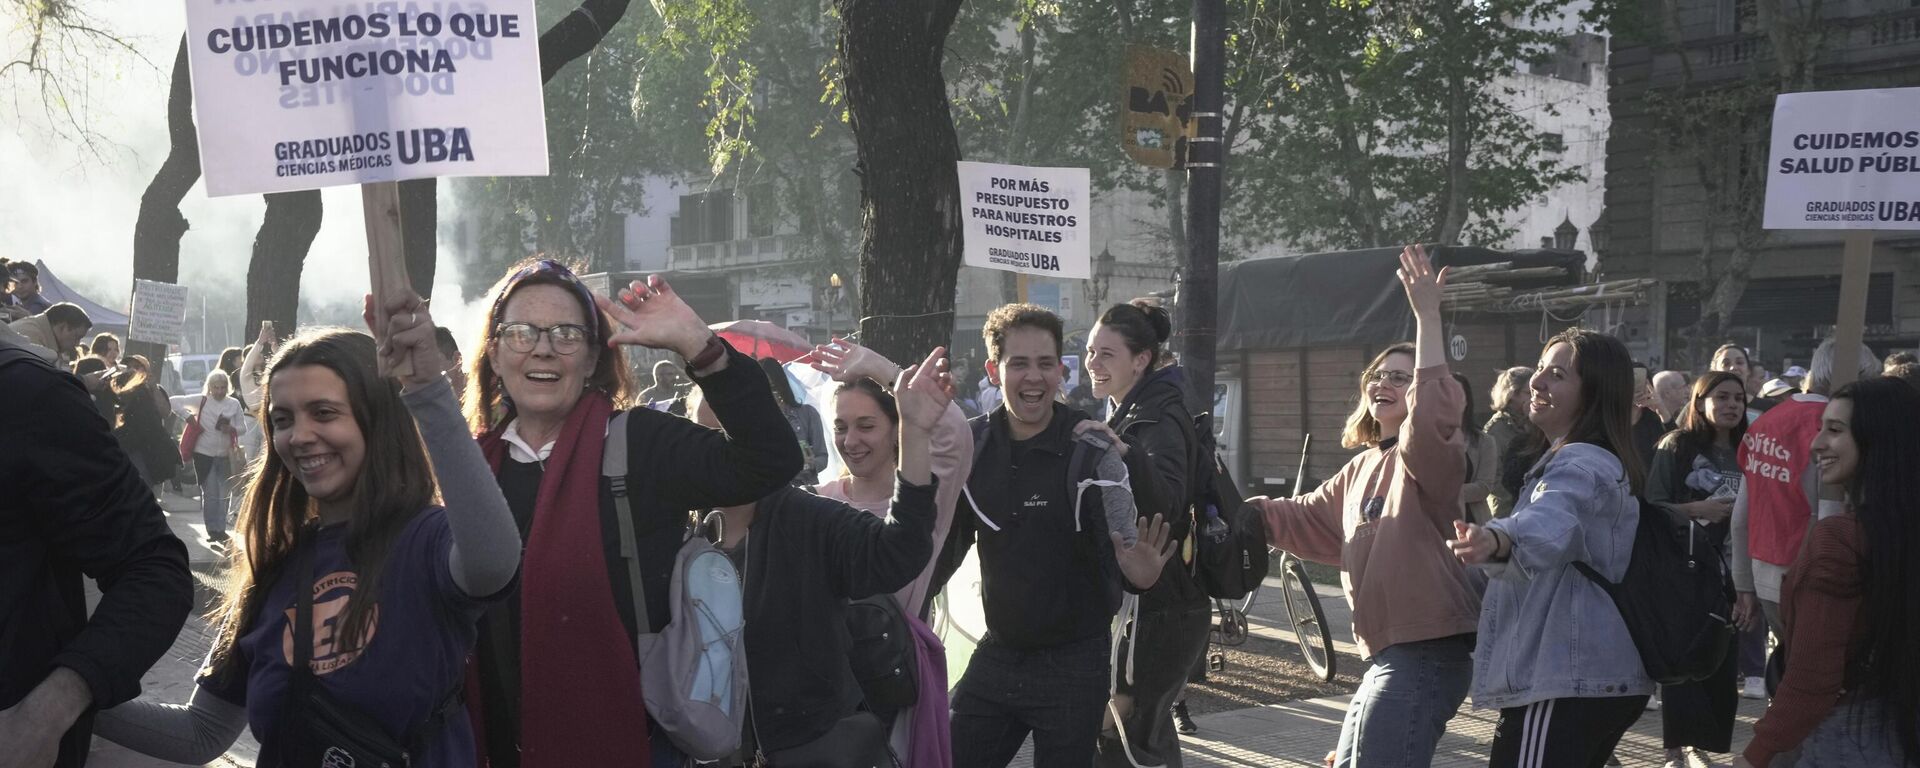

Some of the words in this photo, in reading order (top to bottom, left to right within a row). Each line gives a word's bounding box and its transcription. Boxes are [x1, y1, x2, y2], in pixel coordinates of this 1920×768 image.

[208, 13, 391, 54] CUIDEMOS
[398, 12, 442, 37] LO
[449, 13, 520, 41] QUE
[279, 49, 456, 86] FUNCIONA
[275, 132, 391, 161] GRADUADOS
[397, 127, 475, 165] UBA
[1793, 131, 1919, 151] CUIDEMOS
[276, 161, 336, 177] CIENCIAS
[339, 154, 392, 173] MÉDICAS
[1779, 157, 1854, 174] SALUD
[991, 177, 1016, 190] POR
[1018, 178, 1050, 193] MÁS
[976, 192, 1070, 211] PRESUPUESTO
[1806, 201, 1876, 212] GRADUADOS
[972, 207, 1004, 221] PARA
[1005, 212, 1077, 227] NUESTROS
[1805, 213, 1840, 221] CIENCIAS
[1878, 201, 1920, 222] UBA
[985, 224, 1062, 243] HOSPITALES
[989, 247, 1030, 261] GRADUADOS
[1031, 253, 1060, 271] UBA
[1452, 340, 1466, 357] 110
[1743, 432, 1791, 462] olítica
[1745, 453, 1791, 483] rera
[313, 576, 357, 595] UTRICIO
